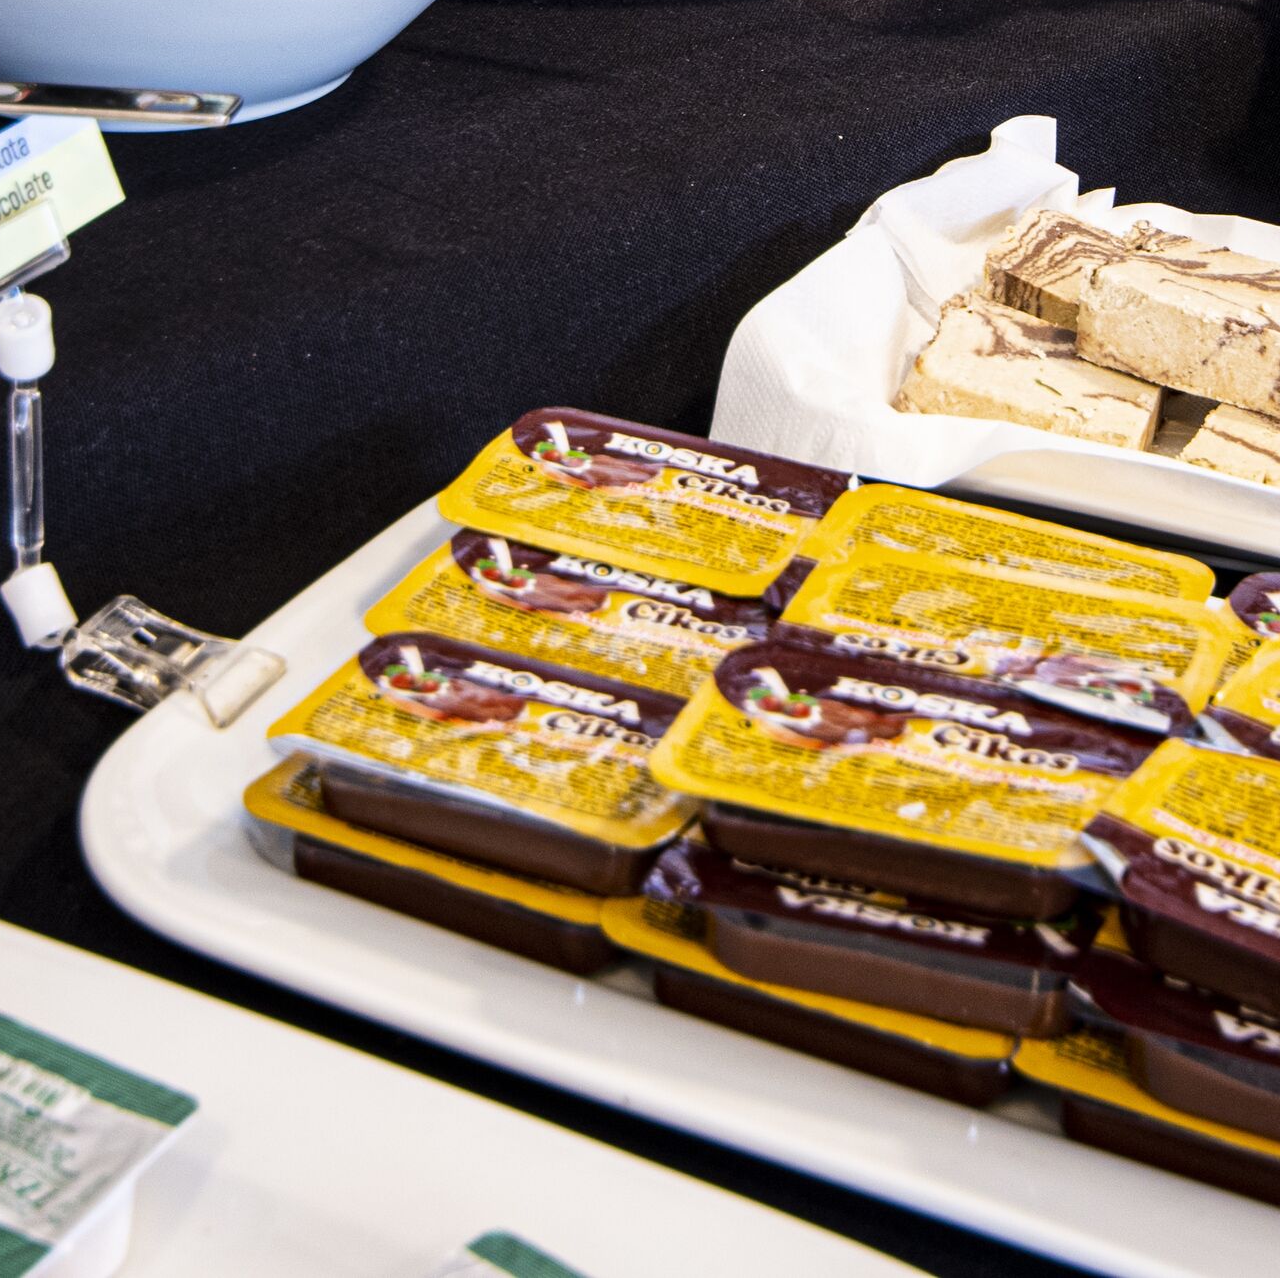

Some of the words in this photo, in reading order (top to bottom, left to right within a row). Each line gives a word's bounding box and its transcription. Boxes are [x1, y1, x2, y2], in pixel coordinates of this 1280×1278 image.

[604, 432, 761, 487] KOSKA
[549, 554, 716, 611] KOSKA
[462, 660, 642, 725] KOSKA
[830, 676, 1033, 737] KOSKA
[776, 884, 992, 949] KOSKA
